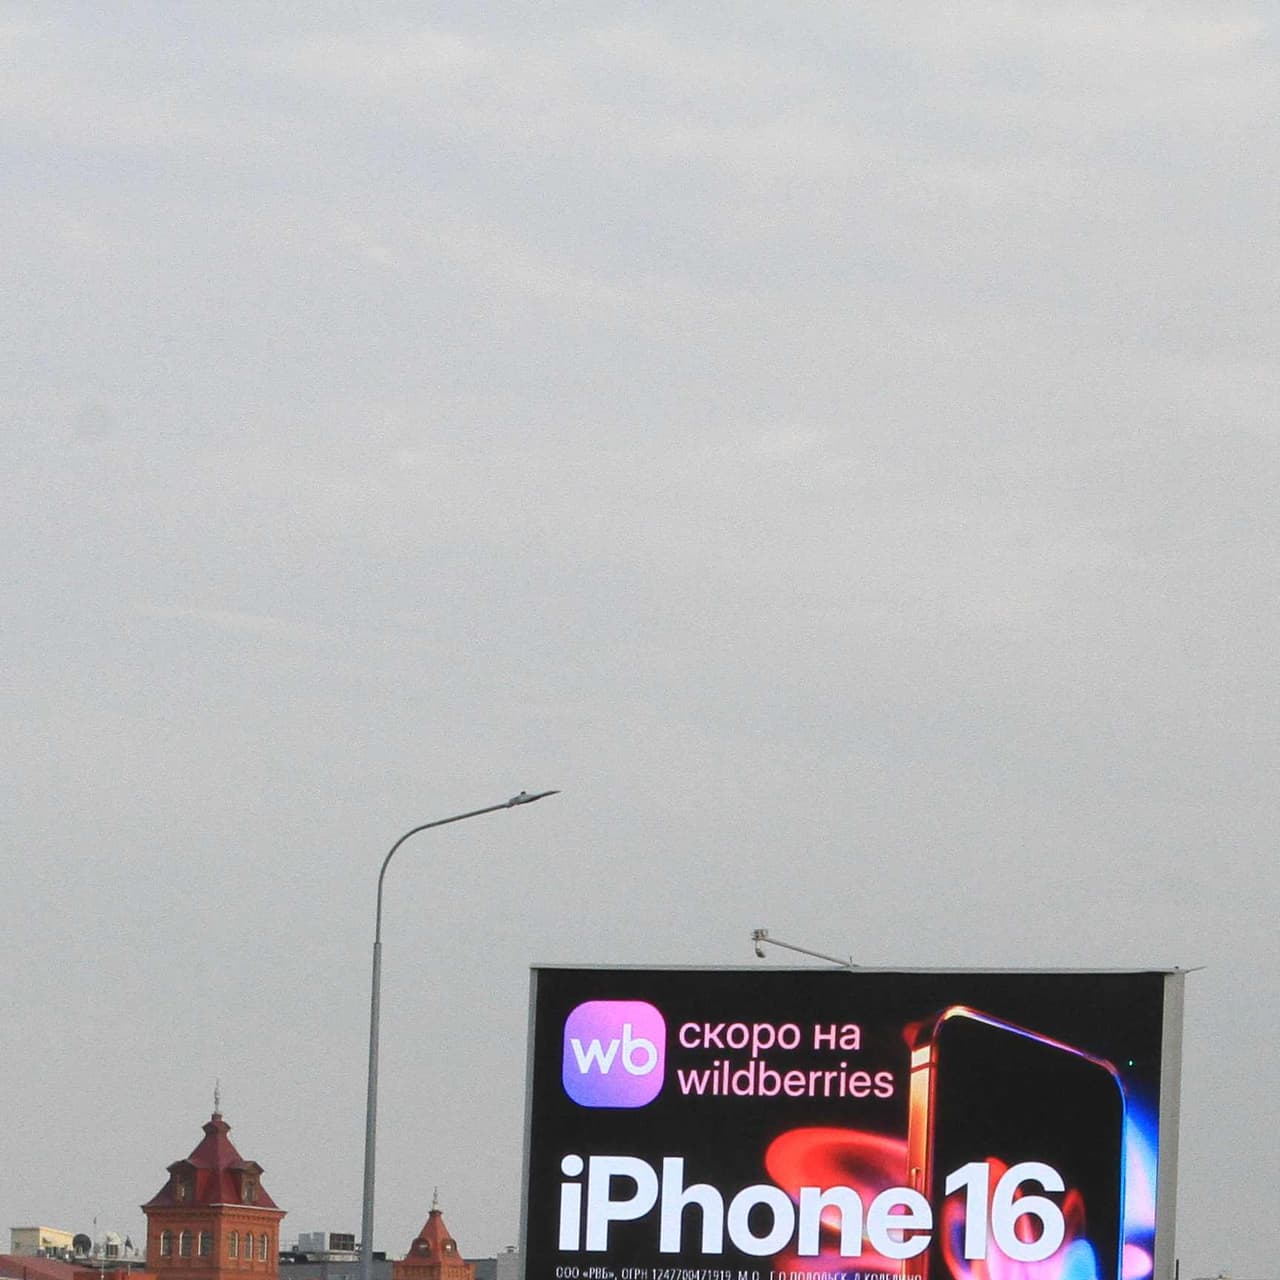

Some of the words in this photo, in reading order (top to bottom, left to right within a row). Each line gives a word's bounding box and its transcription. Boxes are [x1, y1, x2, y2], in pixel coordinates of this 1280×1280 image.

[570, 1023, 658, 1075] wb
[678, 1022, 801, 1058] скоро
[813, 1023, 861, 1050] на
[677, 1060, 895, 1099] wildberries
[558, 1154, 933, 1260] iPhone
[944, 1161, 1066, 1263] 16
[555, 1267, 580, 1279] ООО
[621, 1268, 648, 1280] ОГРН
